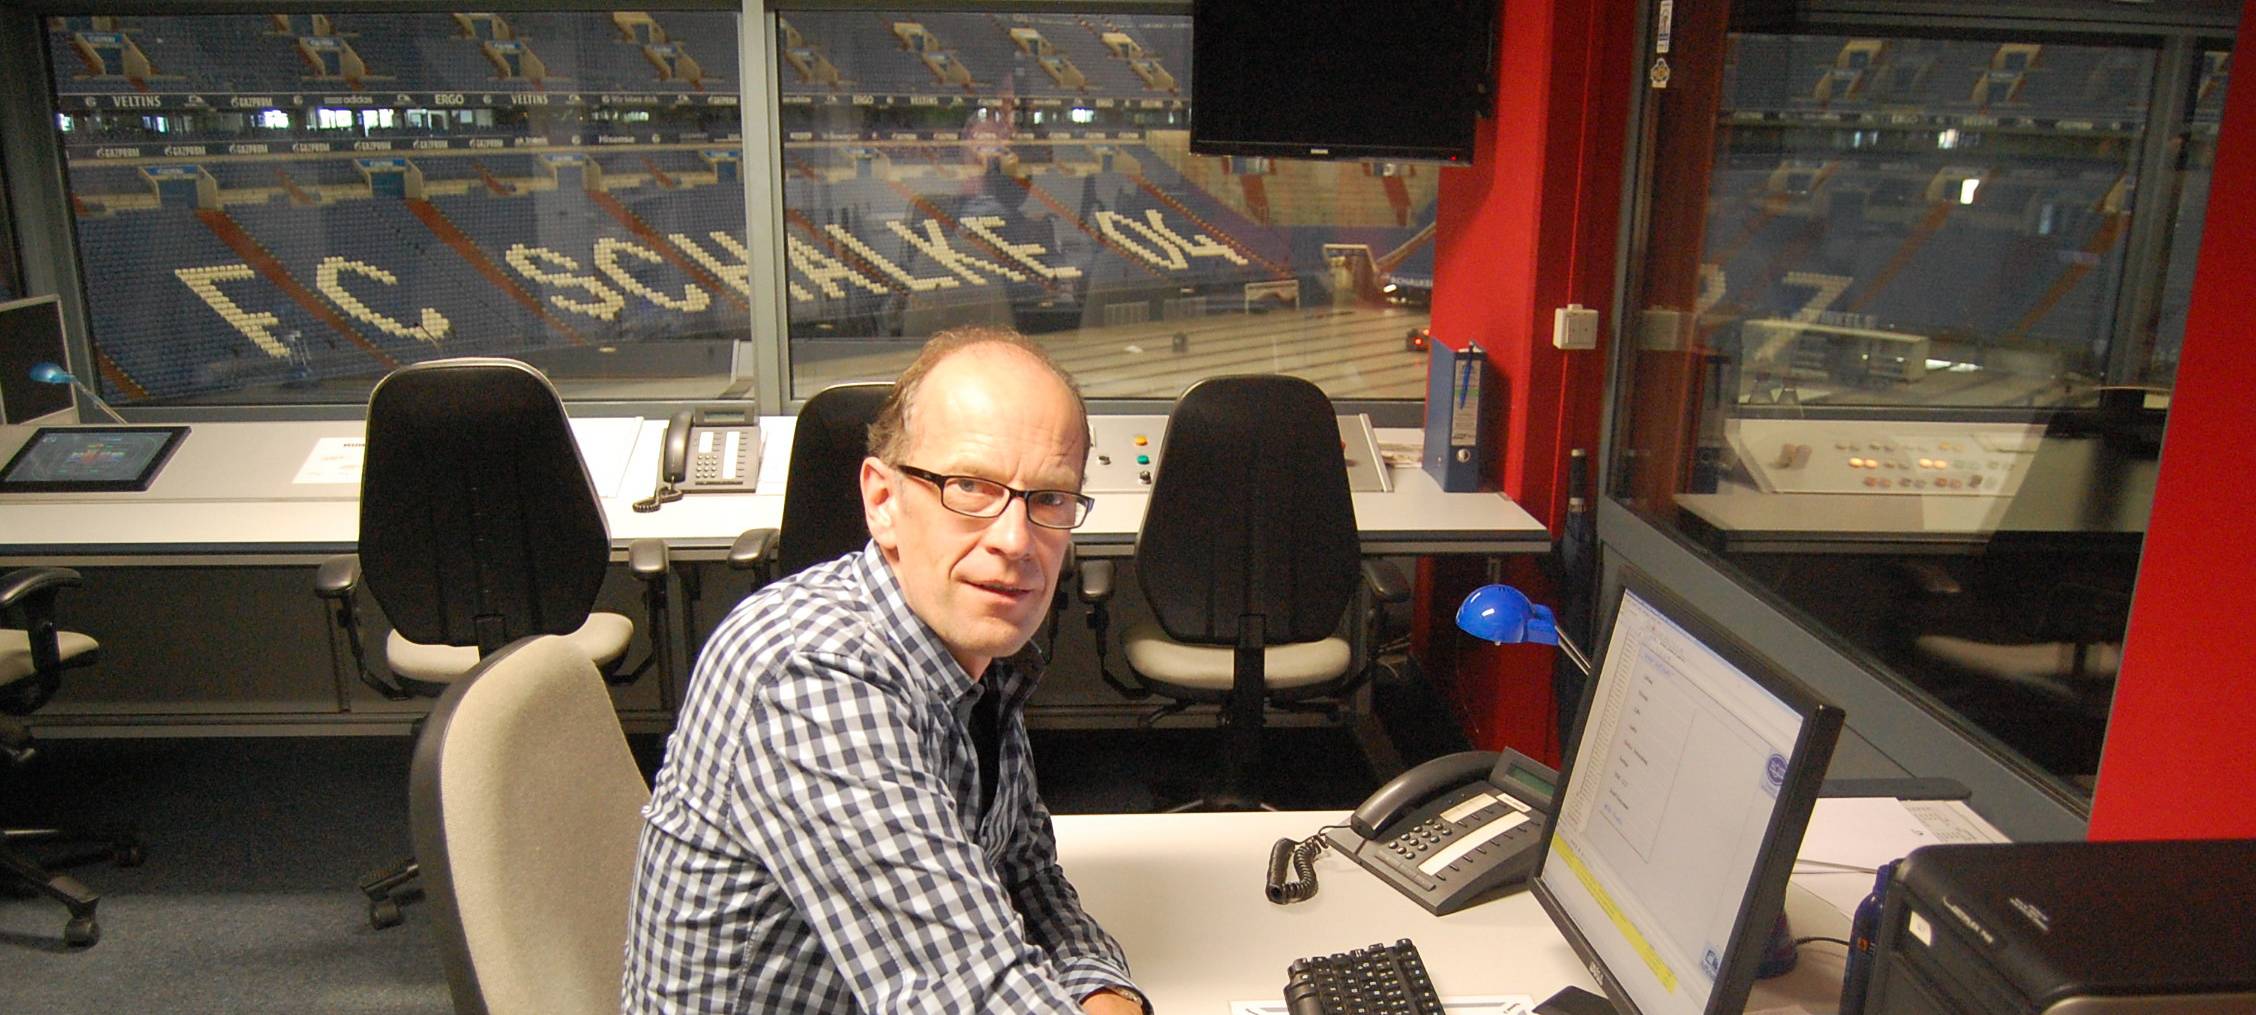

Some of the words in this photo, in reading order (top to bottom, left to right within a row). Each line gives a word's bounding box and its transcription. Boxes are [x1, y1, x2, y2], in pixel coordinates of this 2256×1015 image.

[112, 95, 161, 107] VELTINS
[435, 94, 465, 105] ERGO
[511, 94, 549, 105] VELTINS
[504, 216, 1082, 321] SCHALKE
[1096, 209, 1249, 271] 04
